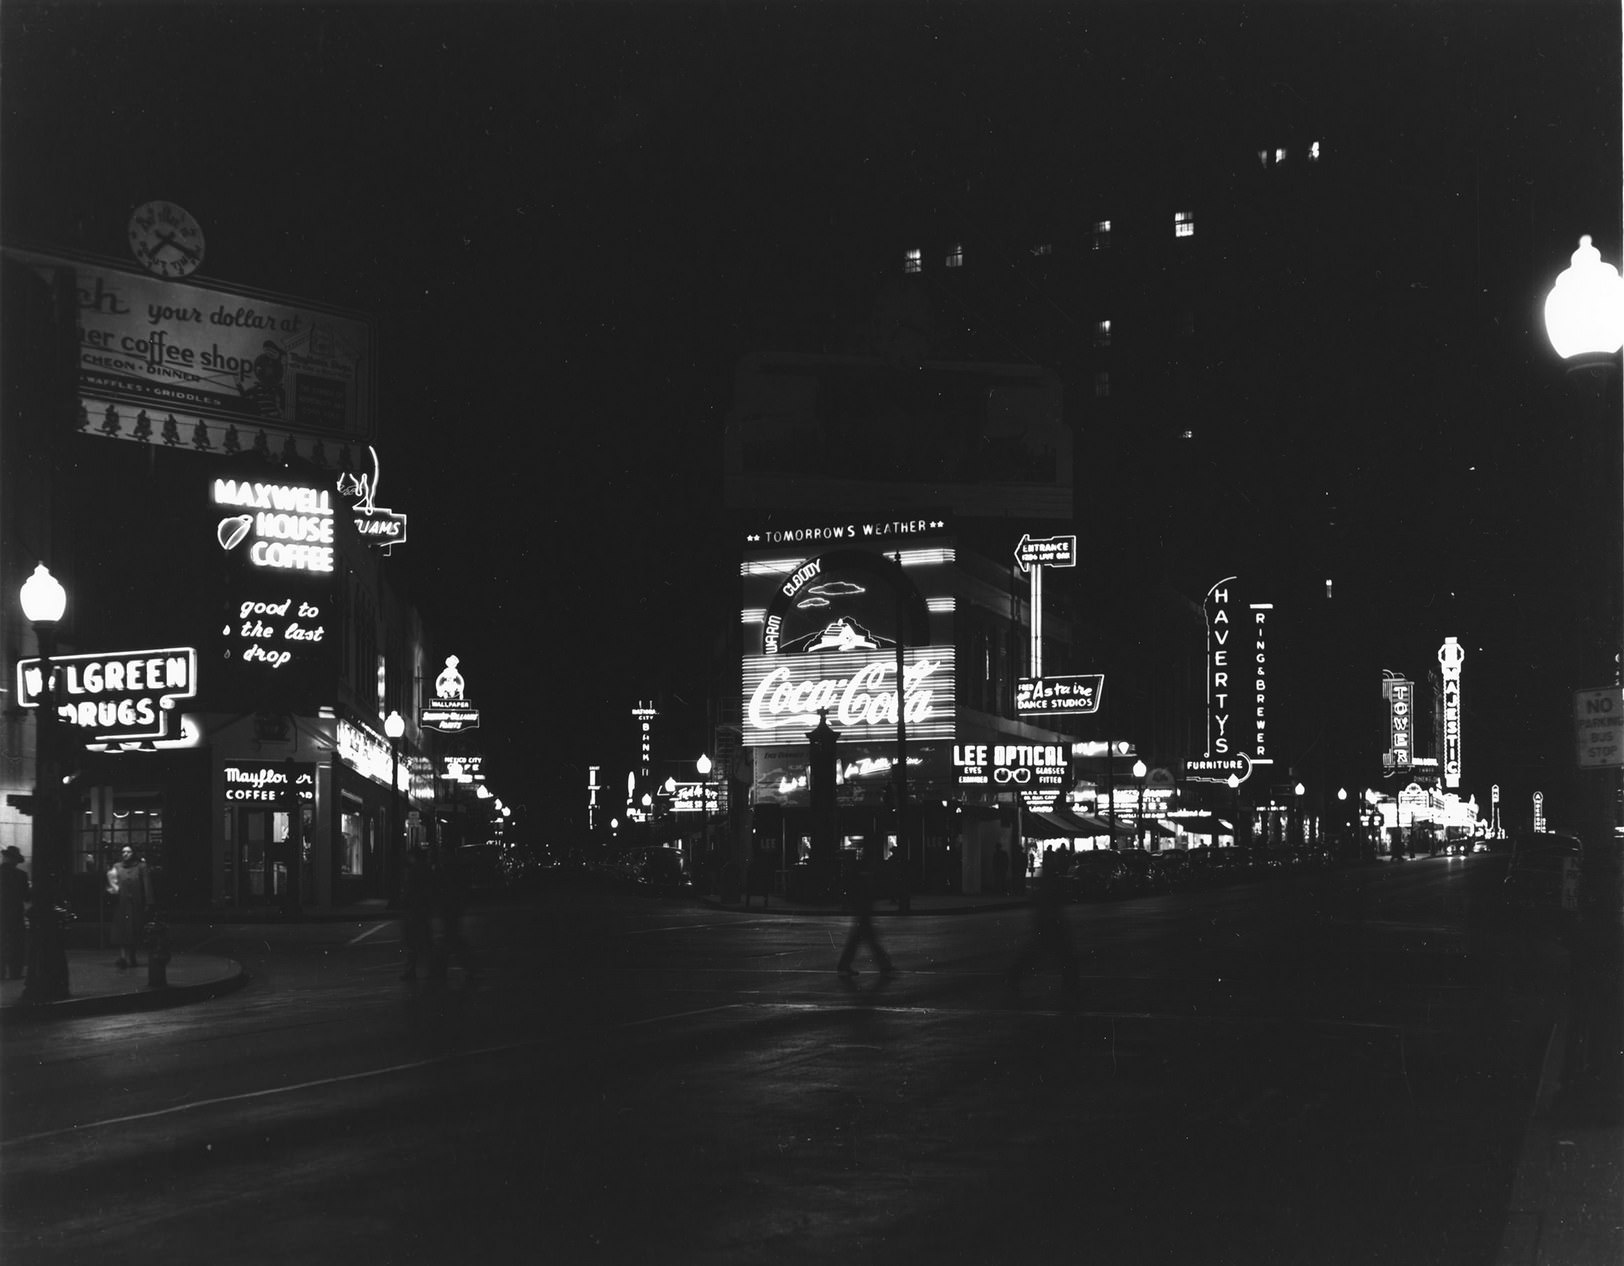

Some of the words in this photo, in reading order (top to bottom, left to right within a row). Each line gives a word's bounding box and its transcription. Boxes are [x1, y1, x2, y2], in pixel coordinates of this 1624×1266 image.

[148, 303, 203, 325] your
[210, 305, 276, 331] dollar
[280, 313, 299, 333] at
[121, 330, 194, 366] coffee
[200, 343, 254, 382] shop
[147, 366, 201, 384] DINNER
[86, 376, 143, 394] WAFFLES
[153, 387, 221, 407] GRIDDLES
[214, 479, 334, 516] MAXWELL
[256, 512, 334, 543] HOUSE
[766, 524, 856, 543] TOMORROWS
[862, 519, 927, 536] WEATHER
[250, 540, 334, 573] COFFEE
[1022, 542, 1069, 553] ENTRANCE
[782, 558, 821, 597] CLOUDY
[240, 599, 292, 619] good
[297, 602, 320, 618] to
[240, 620, 274, 639] the
[284, 623, 325, 642] last
[765, 614, 782, 654] WARM
[242, 643, 292, 669] drop
[747, 658, 942, 730] Coca-Cola
[1032, 680, 1093, 700] Astaire
[1017, 699, 1048, 710] DANCE
[1051, 698, 1093, 708] STUDIOS
[1586, 697, 1613, 715] NO
[1393, 685, 1409, 764] TOWER
[1444, 667, 1459, 774] MAJESTIC
[642, 722, 650, 761] BANK
[1591, 731, 1614, 744] BUS
[953, 745, 988, 766] LEE
[994, 745, 1068, 766] OPTICAL
[1587, 745, 1618, 759] STOP
[964, 766, 982, 774] EYES
[1035, 767, 1065, 775] GLASSES
[1186, 760, 1243, 770] FURNITURE
[223, 767, 314, 789] Mayfloer
[1039, 776, 1062, 784] FITTED
[225, 789, 276, 801] COFFEE
